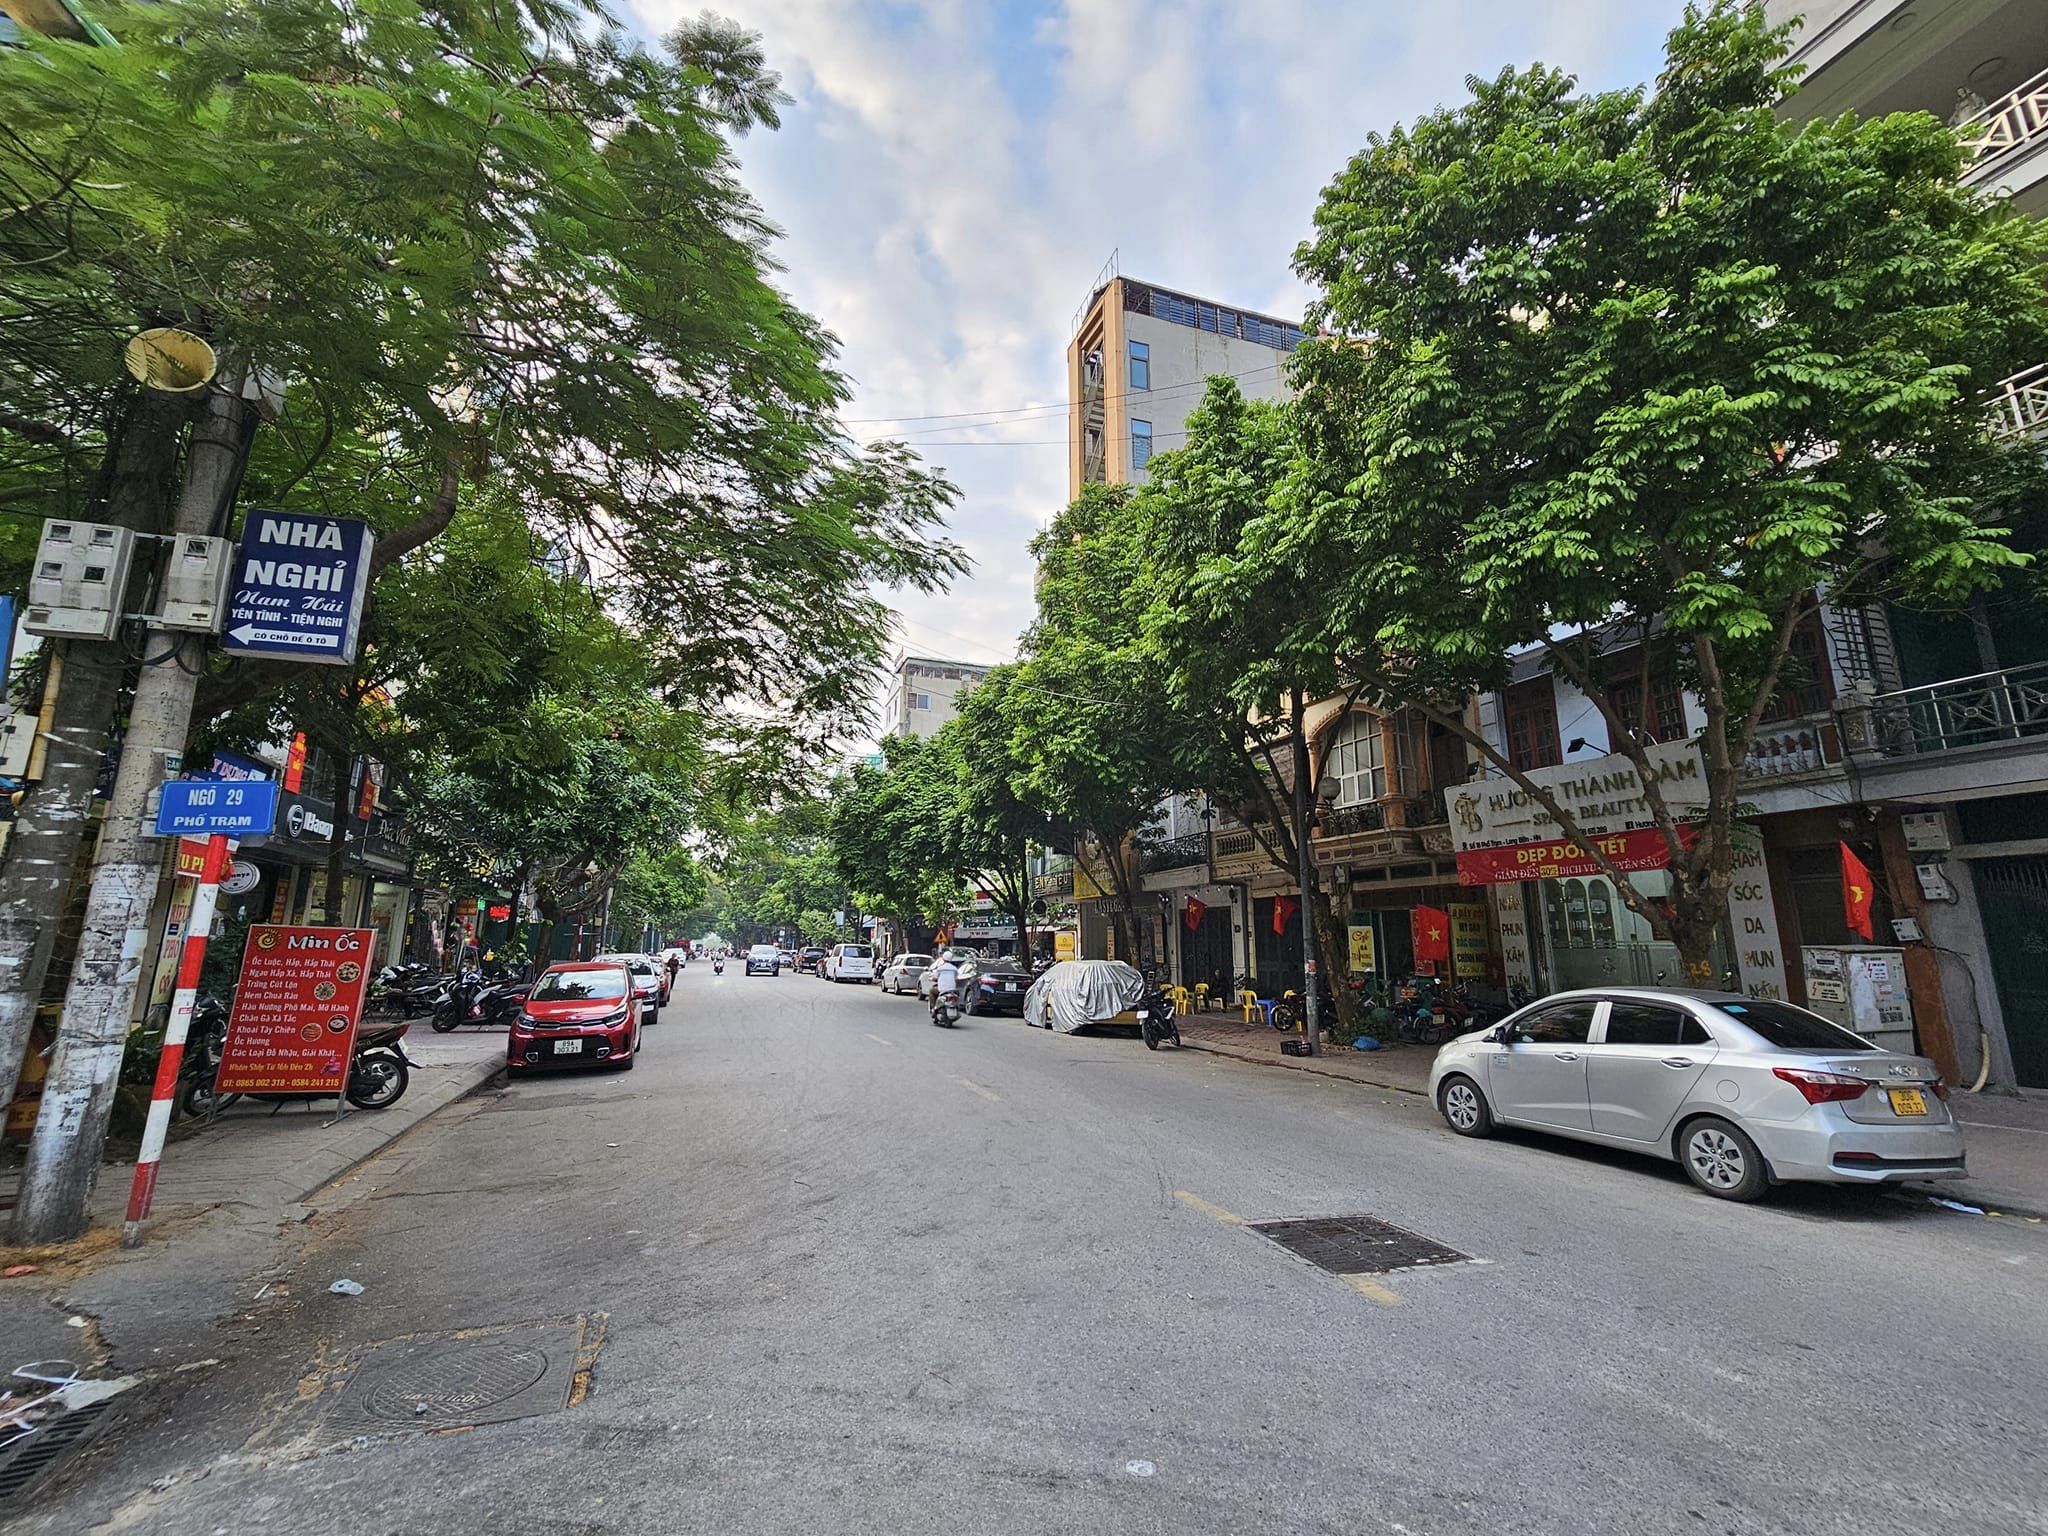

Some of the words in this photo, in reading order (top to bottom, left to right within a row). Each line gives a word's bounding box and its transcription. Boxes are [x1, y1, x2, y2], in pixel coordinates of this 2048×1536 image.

[259, 519, 343, 551] NHÀ
[243, 559, 348, 593] NGHỈ
[231, 608, 253, 620] YÊN
[255, 609, 281, 622] TĨNH
[290, 613, 315, 626] TIỆN
[1489, 784, 1555, 812] HƯƠG
[1659, 758, 1699, 784] ÀM
[187, 785, 217, 807] NGÕ
[225, 788, 244, 806] 29
[173, 813, 208, 827] PHỐ
[209, 816, 252, 829] TRẠM
[1516, 847, 1548, 864] ĐẸP
[1597, 833, 1627, 856] TẾT
[1734, 880, 1764, 901] SÓC
[1502, 922, 1525, 937] PHUN
[1744, 917, 1766, 934] DA
[287, 935, 329, 951] Min
[334, 932, 360, 953] Ốc
